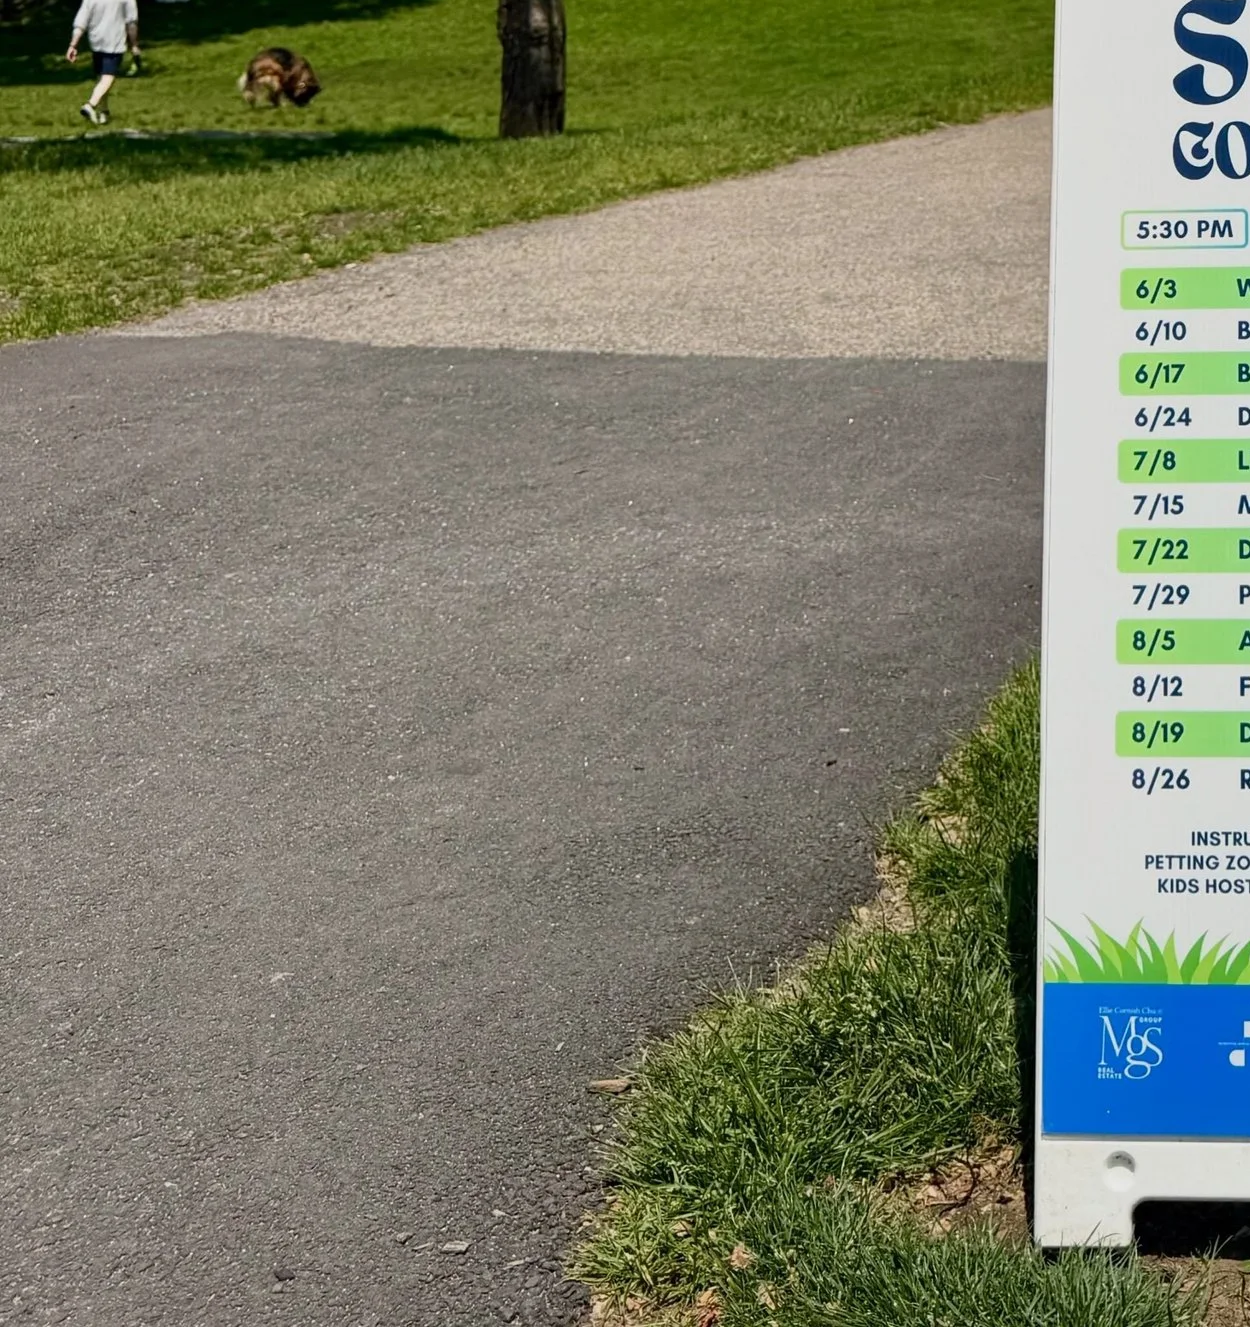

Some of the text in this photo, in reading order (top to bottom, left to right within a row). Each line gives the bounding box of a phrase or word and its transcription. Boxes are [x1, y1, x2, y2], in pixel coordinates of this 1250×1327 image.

[1137, 220, 1233, 239] 5:30 PM
[1136, 278, 1176, 304] 6/3
[1136, 320, 1186, 346] 6/10
[1135, 362, 1185, 389] 6/17
[1135, 406, 1192, 432] 6/24
[1134, 449, 1176, 476] 7/8
[1134, 493, 1183, 520] 7/15
[1133, 538, 1188, 565] 7/22
[1133, 583, 1189, 610] 7/29
[1133, 629, 1175, 656] 8/5
[1133, 675, 1182, 702] 8/12
[1132, 721, 1184, 748] 8/19
[1132, 767, 1190, 795] 8/26
[1145, 855, 1219, 870] PETTING
[1158, 879, 1199, 893] KIDS
